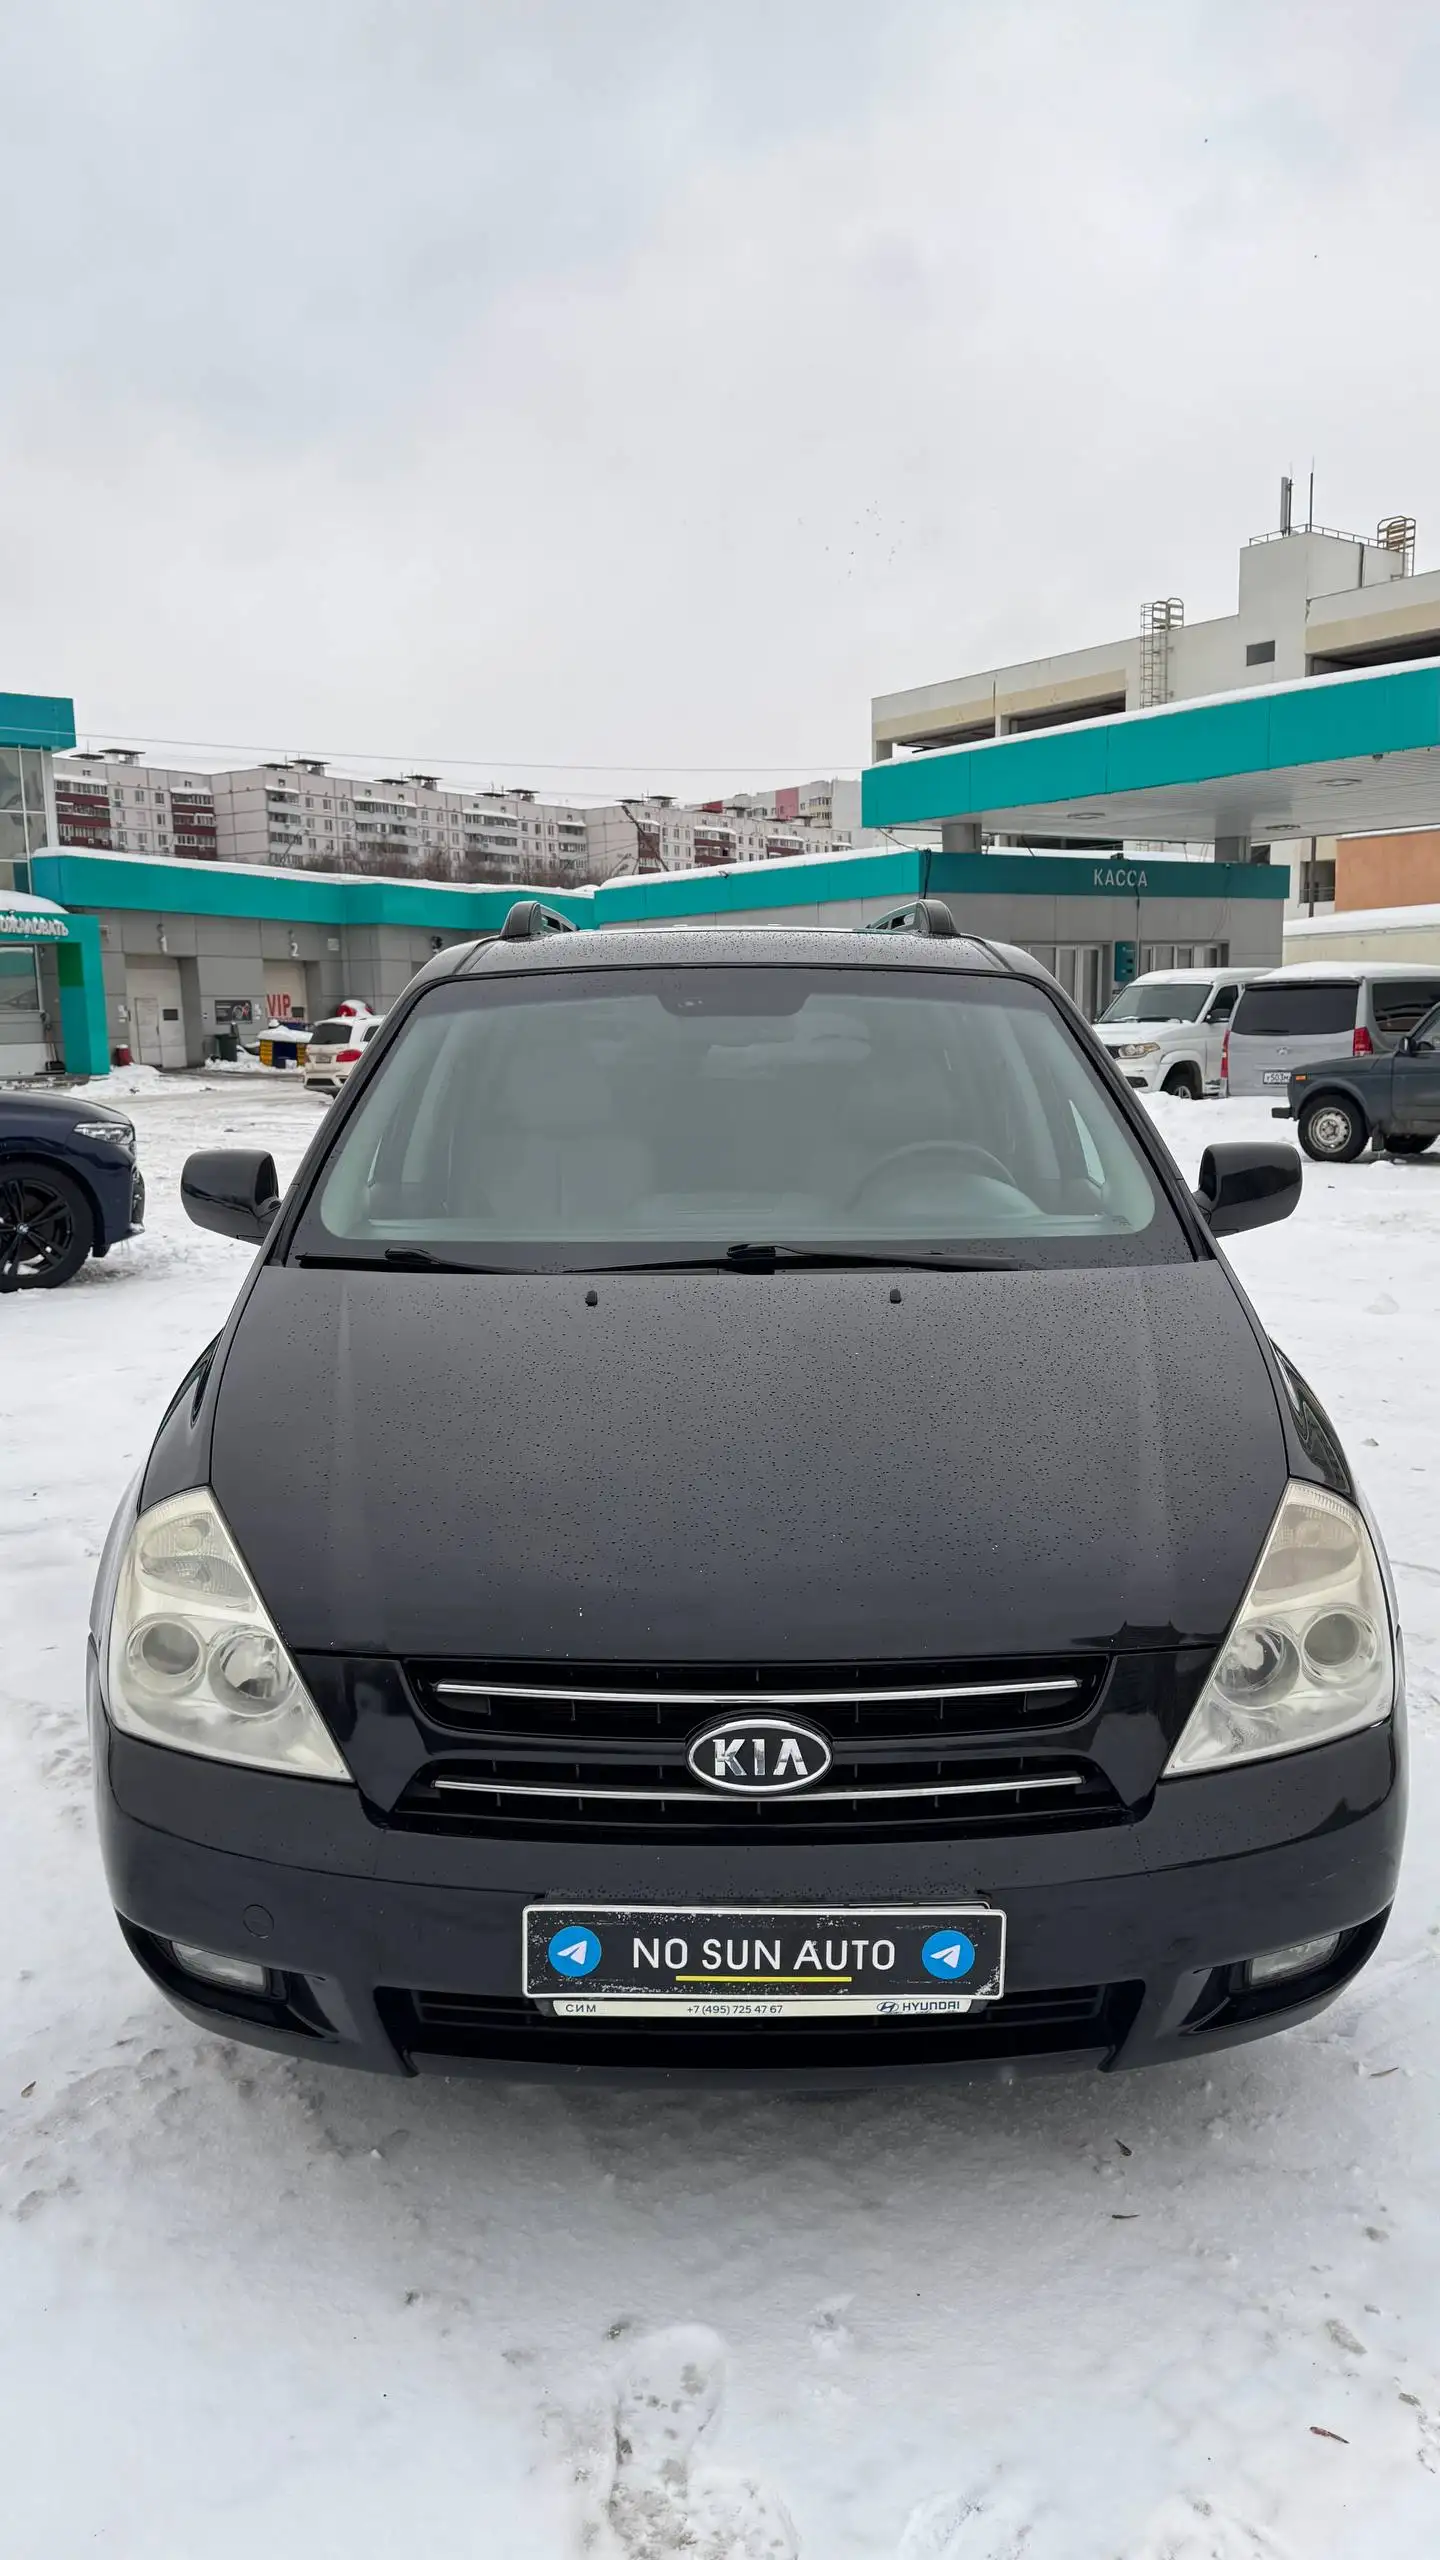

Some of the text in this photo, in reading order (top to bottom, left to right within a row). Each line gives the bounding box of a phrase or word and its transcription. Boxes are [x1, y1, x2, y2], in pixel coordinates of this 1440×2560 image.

[1093, 868, 1148, 887] КАССА
[160, 935, 168, 952] 1
[290, 942, 299, 957] 2
[266, 993, 291, 1016] VIP
[712, 1738, 809, 1776] KIA
[633, 1938, 896, 1971] NO SUN AUTO
[565, 2004, 597, 2013] СИМ
[687, 2004, 784, 2015] +7 (495) 725 47 67
[902, 2001, 961, 2011] HYUNDAI
